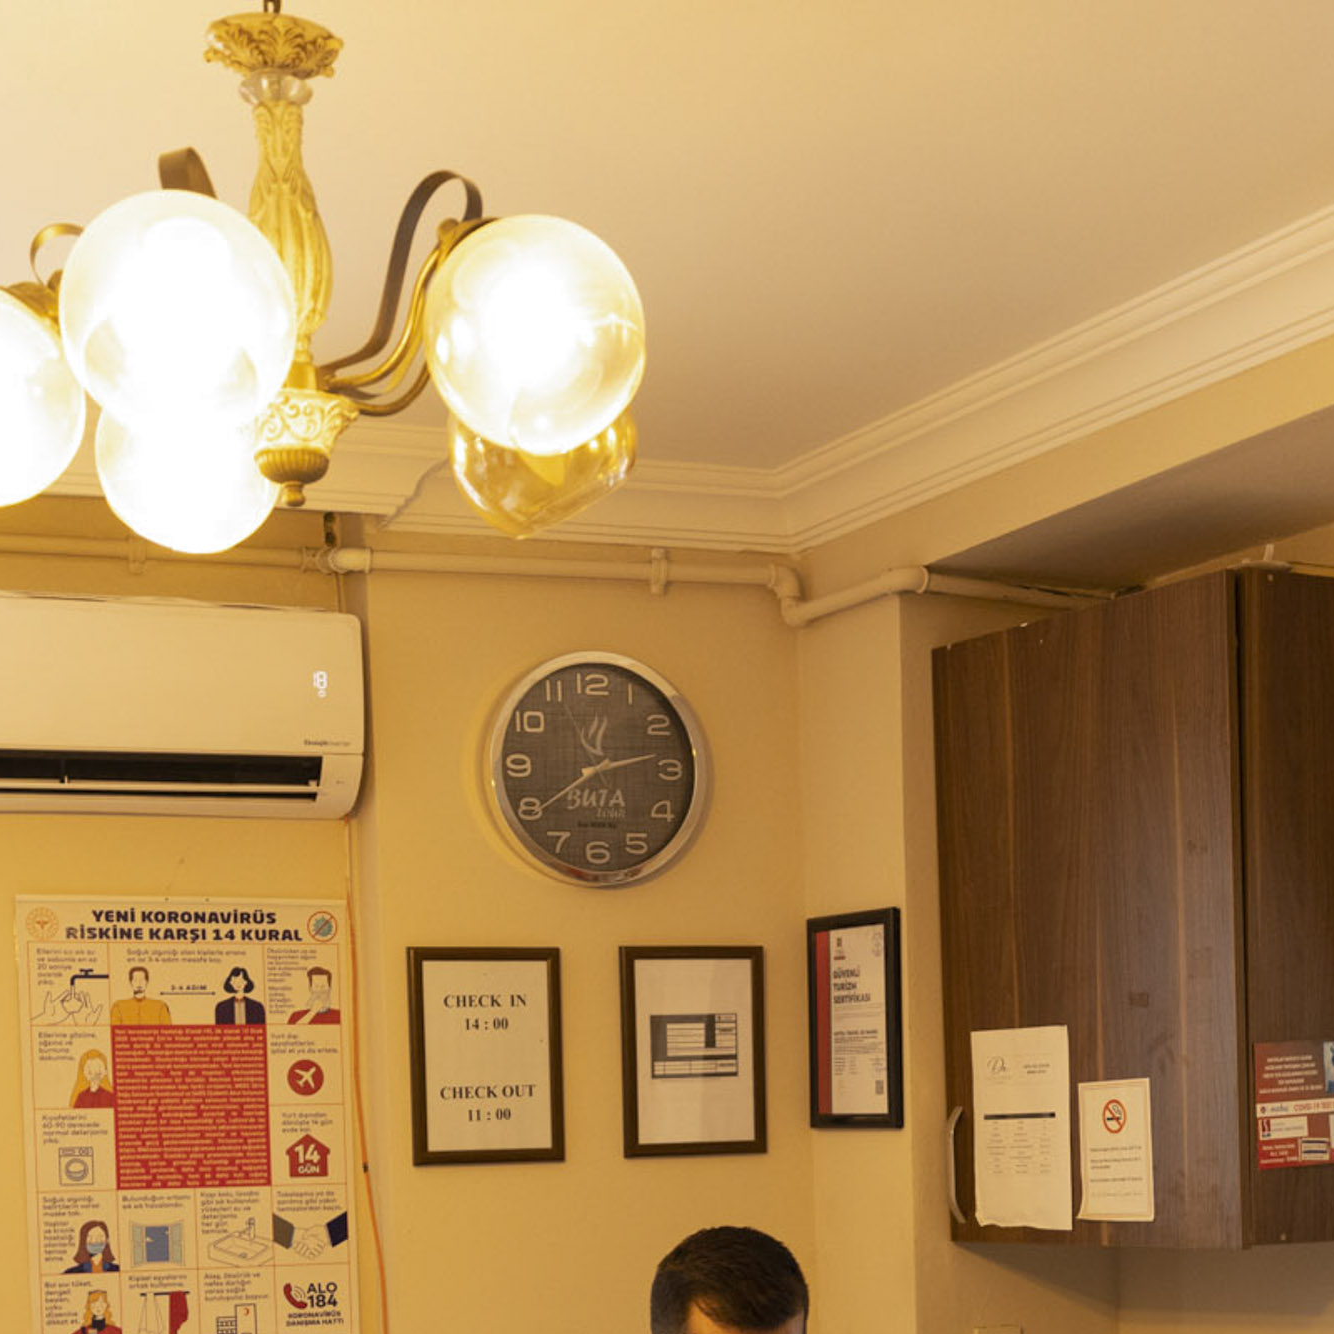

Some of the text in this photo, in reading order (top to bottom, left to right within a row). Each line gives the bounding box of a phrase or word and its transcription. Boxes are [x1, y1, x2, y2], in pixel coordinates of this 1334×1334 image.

[546, 680, 562, 702] 11
[577, 672, 609, 696] 12
[628, 683, 633, 705] 1
[515, 711, 545, 733] 10
[647, 714, 671, 736] 2
[506, 753, 532, 778] 9
[657, 759, 683, 780] 3
[518, 797, 543, 821] 8
[650, 800, 675, 822] 4
[547, 831, 571, 854] 7
[586, 841, 611, 865] 6
[625, 833, 648, 854] 5
[92, 908, 277, 924] YENİ KORONAVİRÜS
[66, 924, 303, 944] RİSKİNE KARŞI 14 KURAL
[443, 994, 527, 1009] CHECK IN
[465, 1018, 479, 1031] 14
[493, 1016, 509, 1030] 00
[440, 1084, 537, 1100] CHECK OUT
[468, 1109, 481, 1122] 11
[495, 1108, 512, 1121] 00
[295, 1144, 321, 1164] 14
[298, 1162, 320, 1174] GÜN
[307, 1282, 338, 1294] ALO
[308, 1294, 338, 1308] 184
